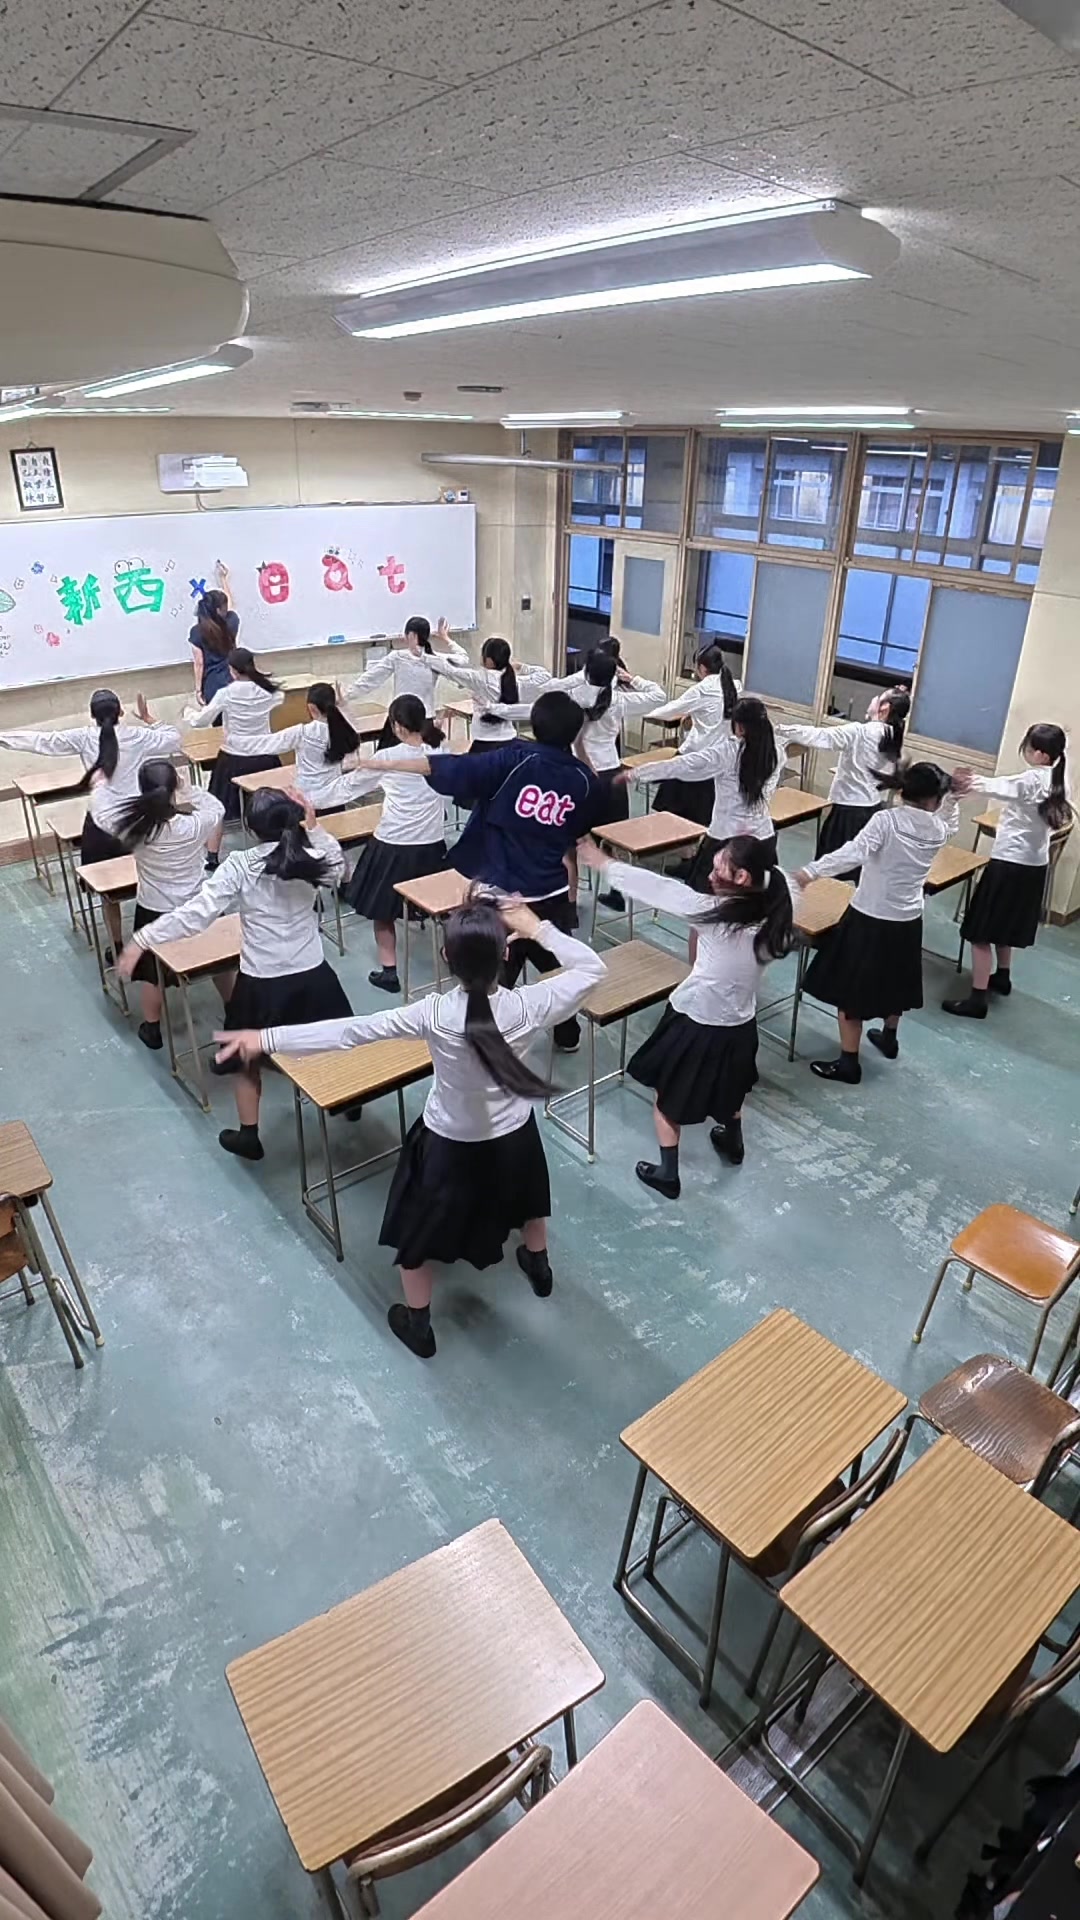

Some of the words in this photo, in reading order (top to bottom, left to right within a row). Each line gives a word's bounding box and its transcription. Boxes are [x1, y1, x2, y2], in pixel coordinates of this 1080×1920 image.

[56, 566, 164, 625] 新西
[259, 555, 405, 603] eat
[515, 784, 575, 826] eat
